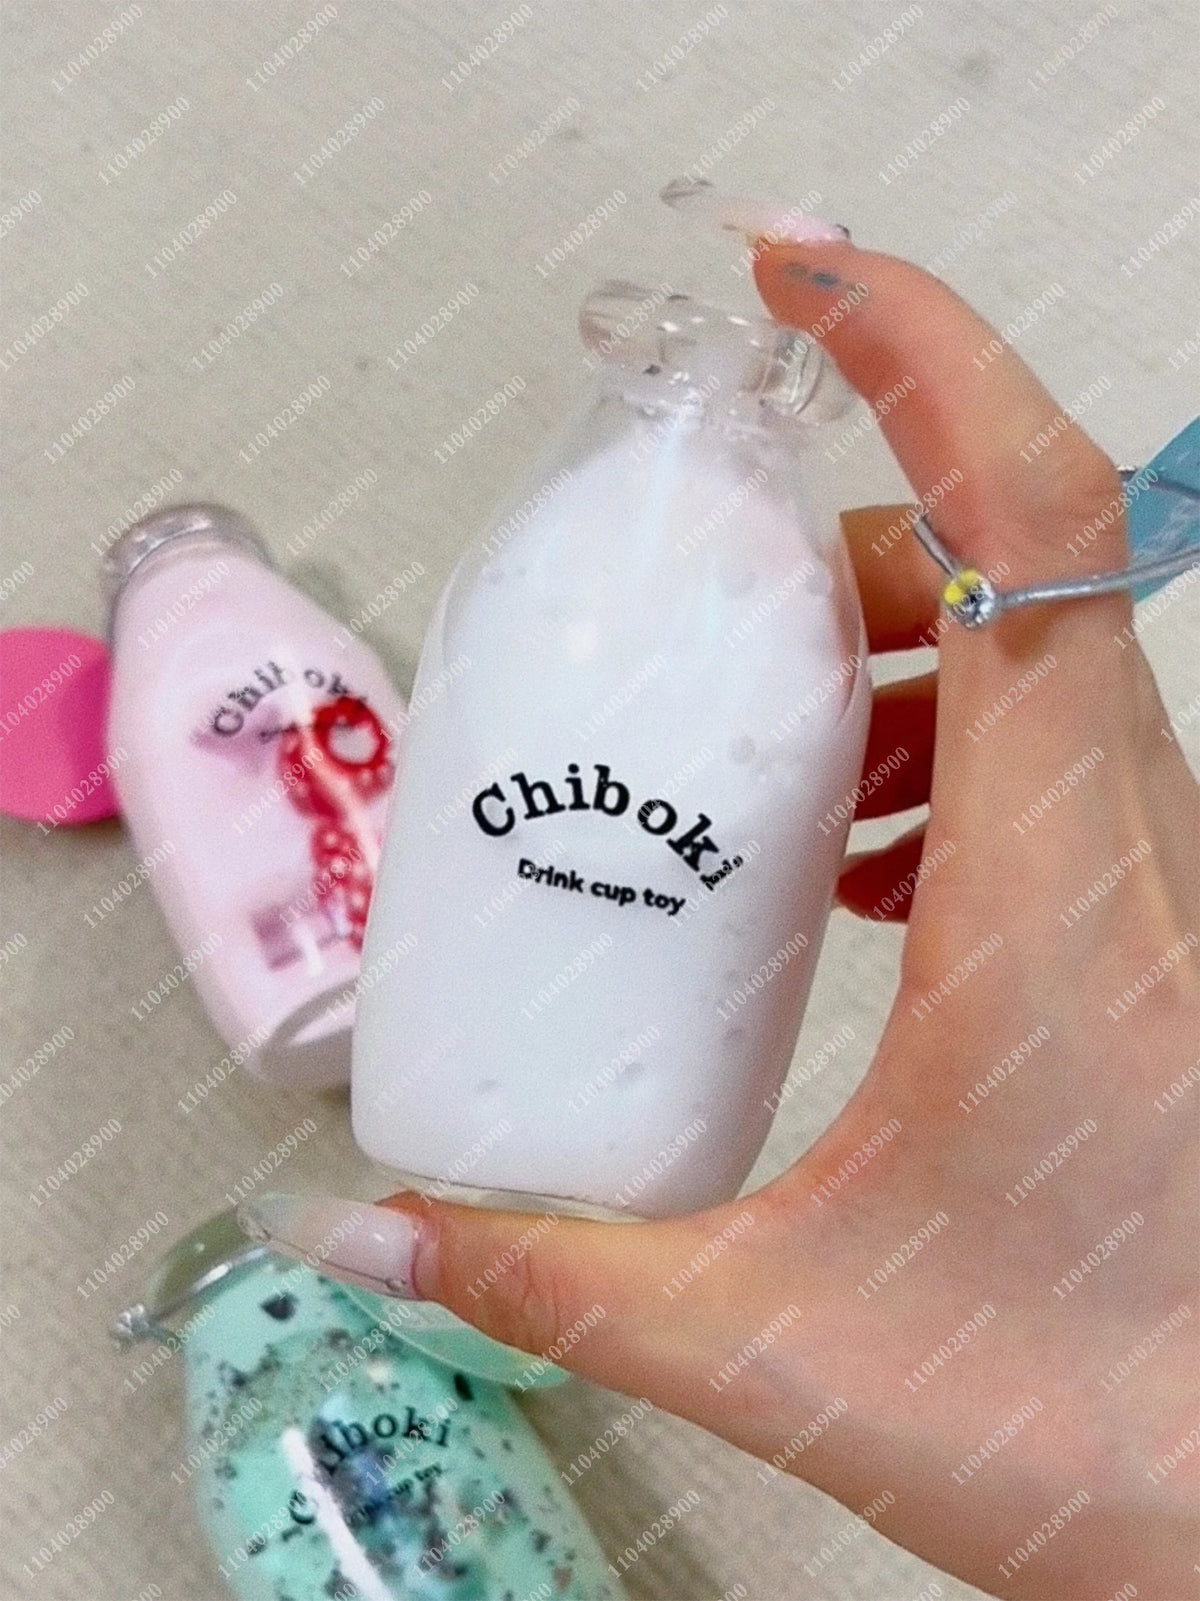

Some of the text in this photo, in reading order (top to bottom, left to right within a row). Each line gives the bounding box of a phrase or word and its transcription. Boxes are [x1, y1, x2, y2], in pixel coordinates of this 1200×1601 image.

[517, 857, 687, 917] Drink cup toy
